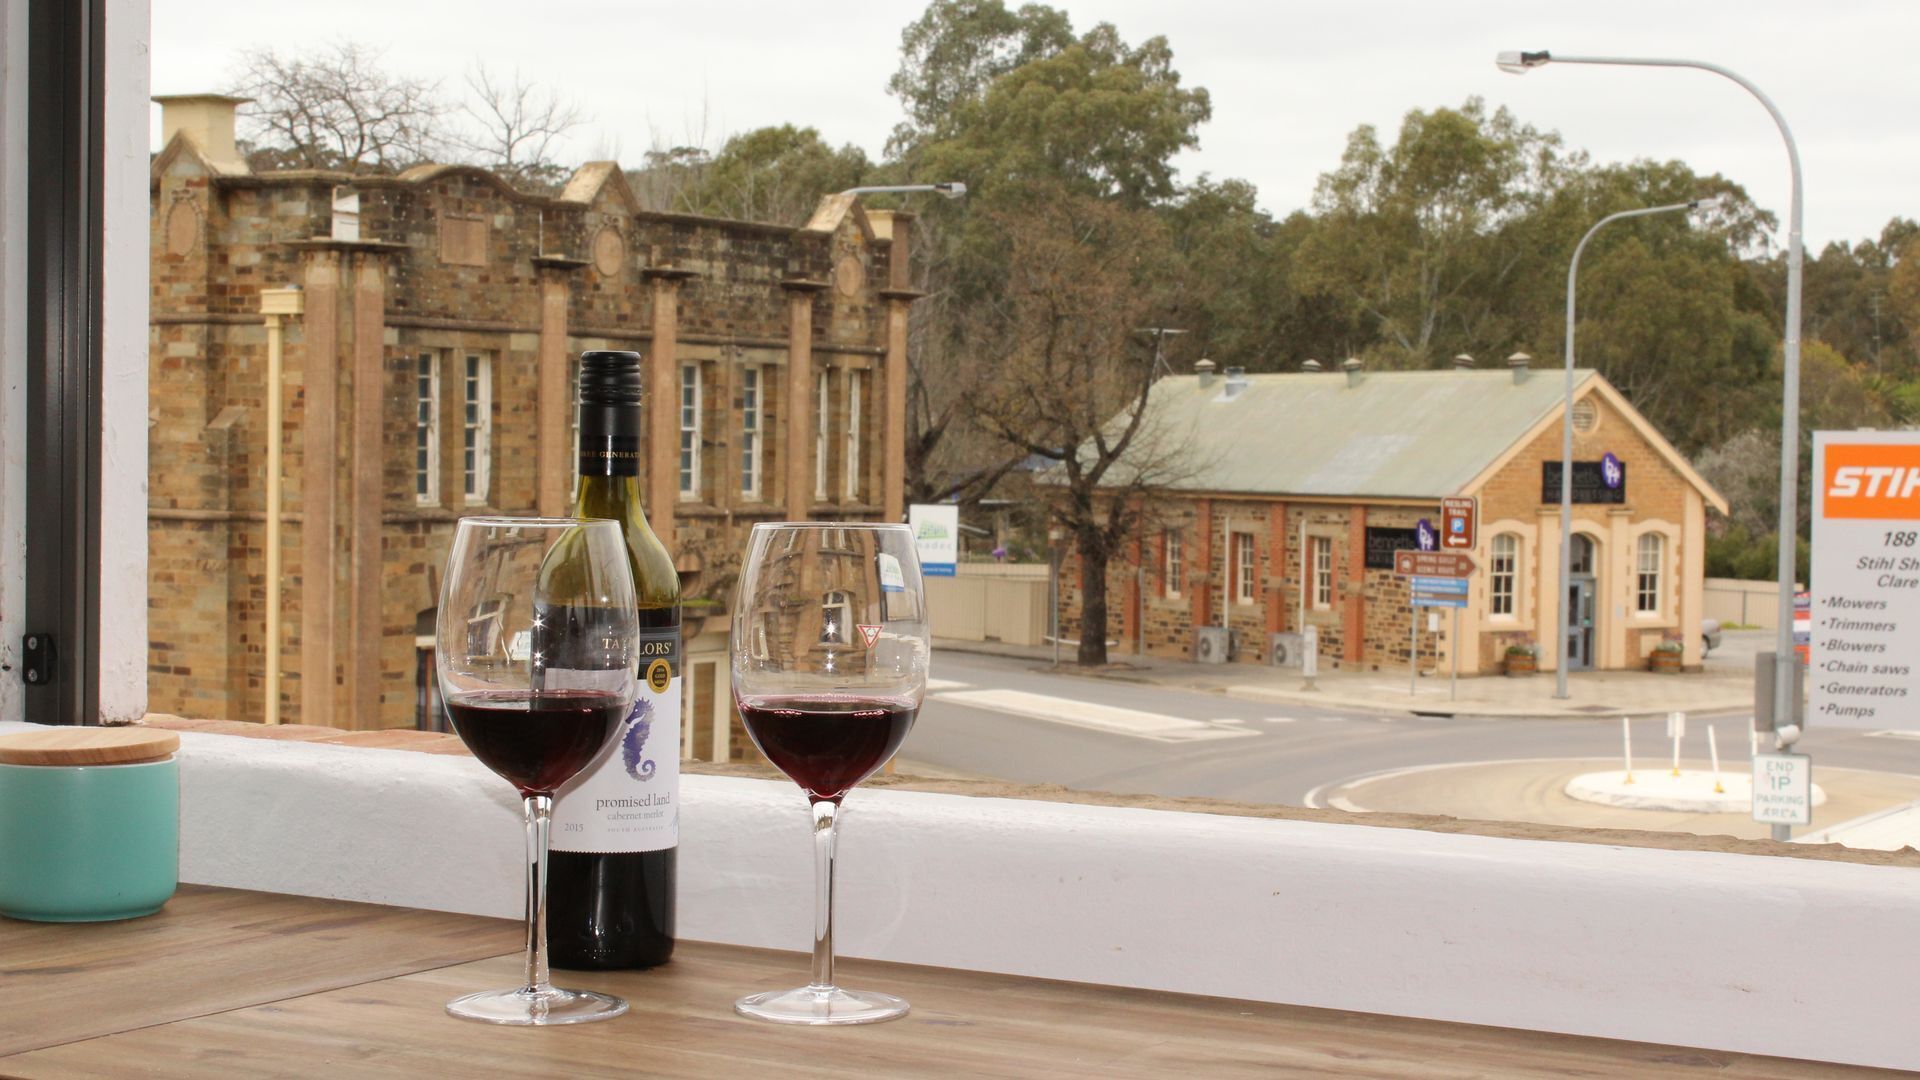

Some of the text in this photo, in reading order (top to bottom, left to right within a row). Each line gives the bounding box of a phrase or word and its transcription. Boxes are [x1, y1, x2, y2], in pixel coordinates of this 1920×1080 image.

[1546, 463, 1600, 485] benetts
[1448, 508, 1468, 517] TRAIL
[1856, 556, 1896, 570] Stihl
[1877, 574, 1920, 589] Clare
[1828, 596, 1888, 610] Mowers
[1828, 617, 1897, 632] Trimmers
[1826, 638, 1887, 653] Blowers
[1826, 659, 1910, 676] Chain saws
[1826, 681, 1909, 697] Generators
[1825, 703, 1876, 719] Pumps
[1766, 760, 1795, 772] END
[1770, 775, 1792, 790] 1P
[596, 792, 670, 811] promised land
[1756, 793, 1804, 806] PARKING
[607, 809, 664, 820] cabernet merlot
[1762, 807, 1798, 818] AREA
[564, 823, 584, 832] 2015
